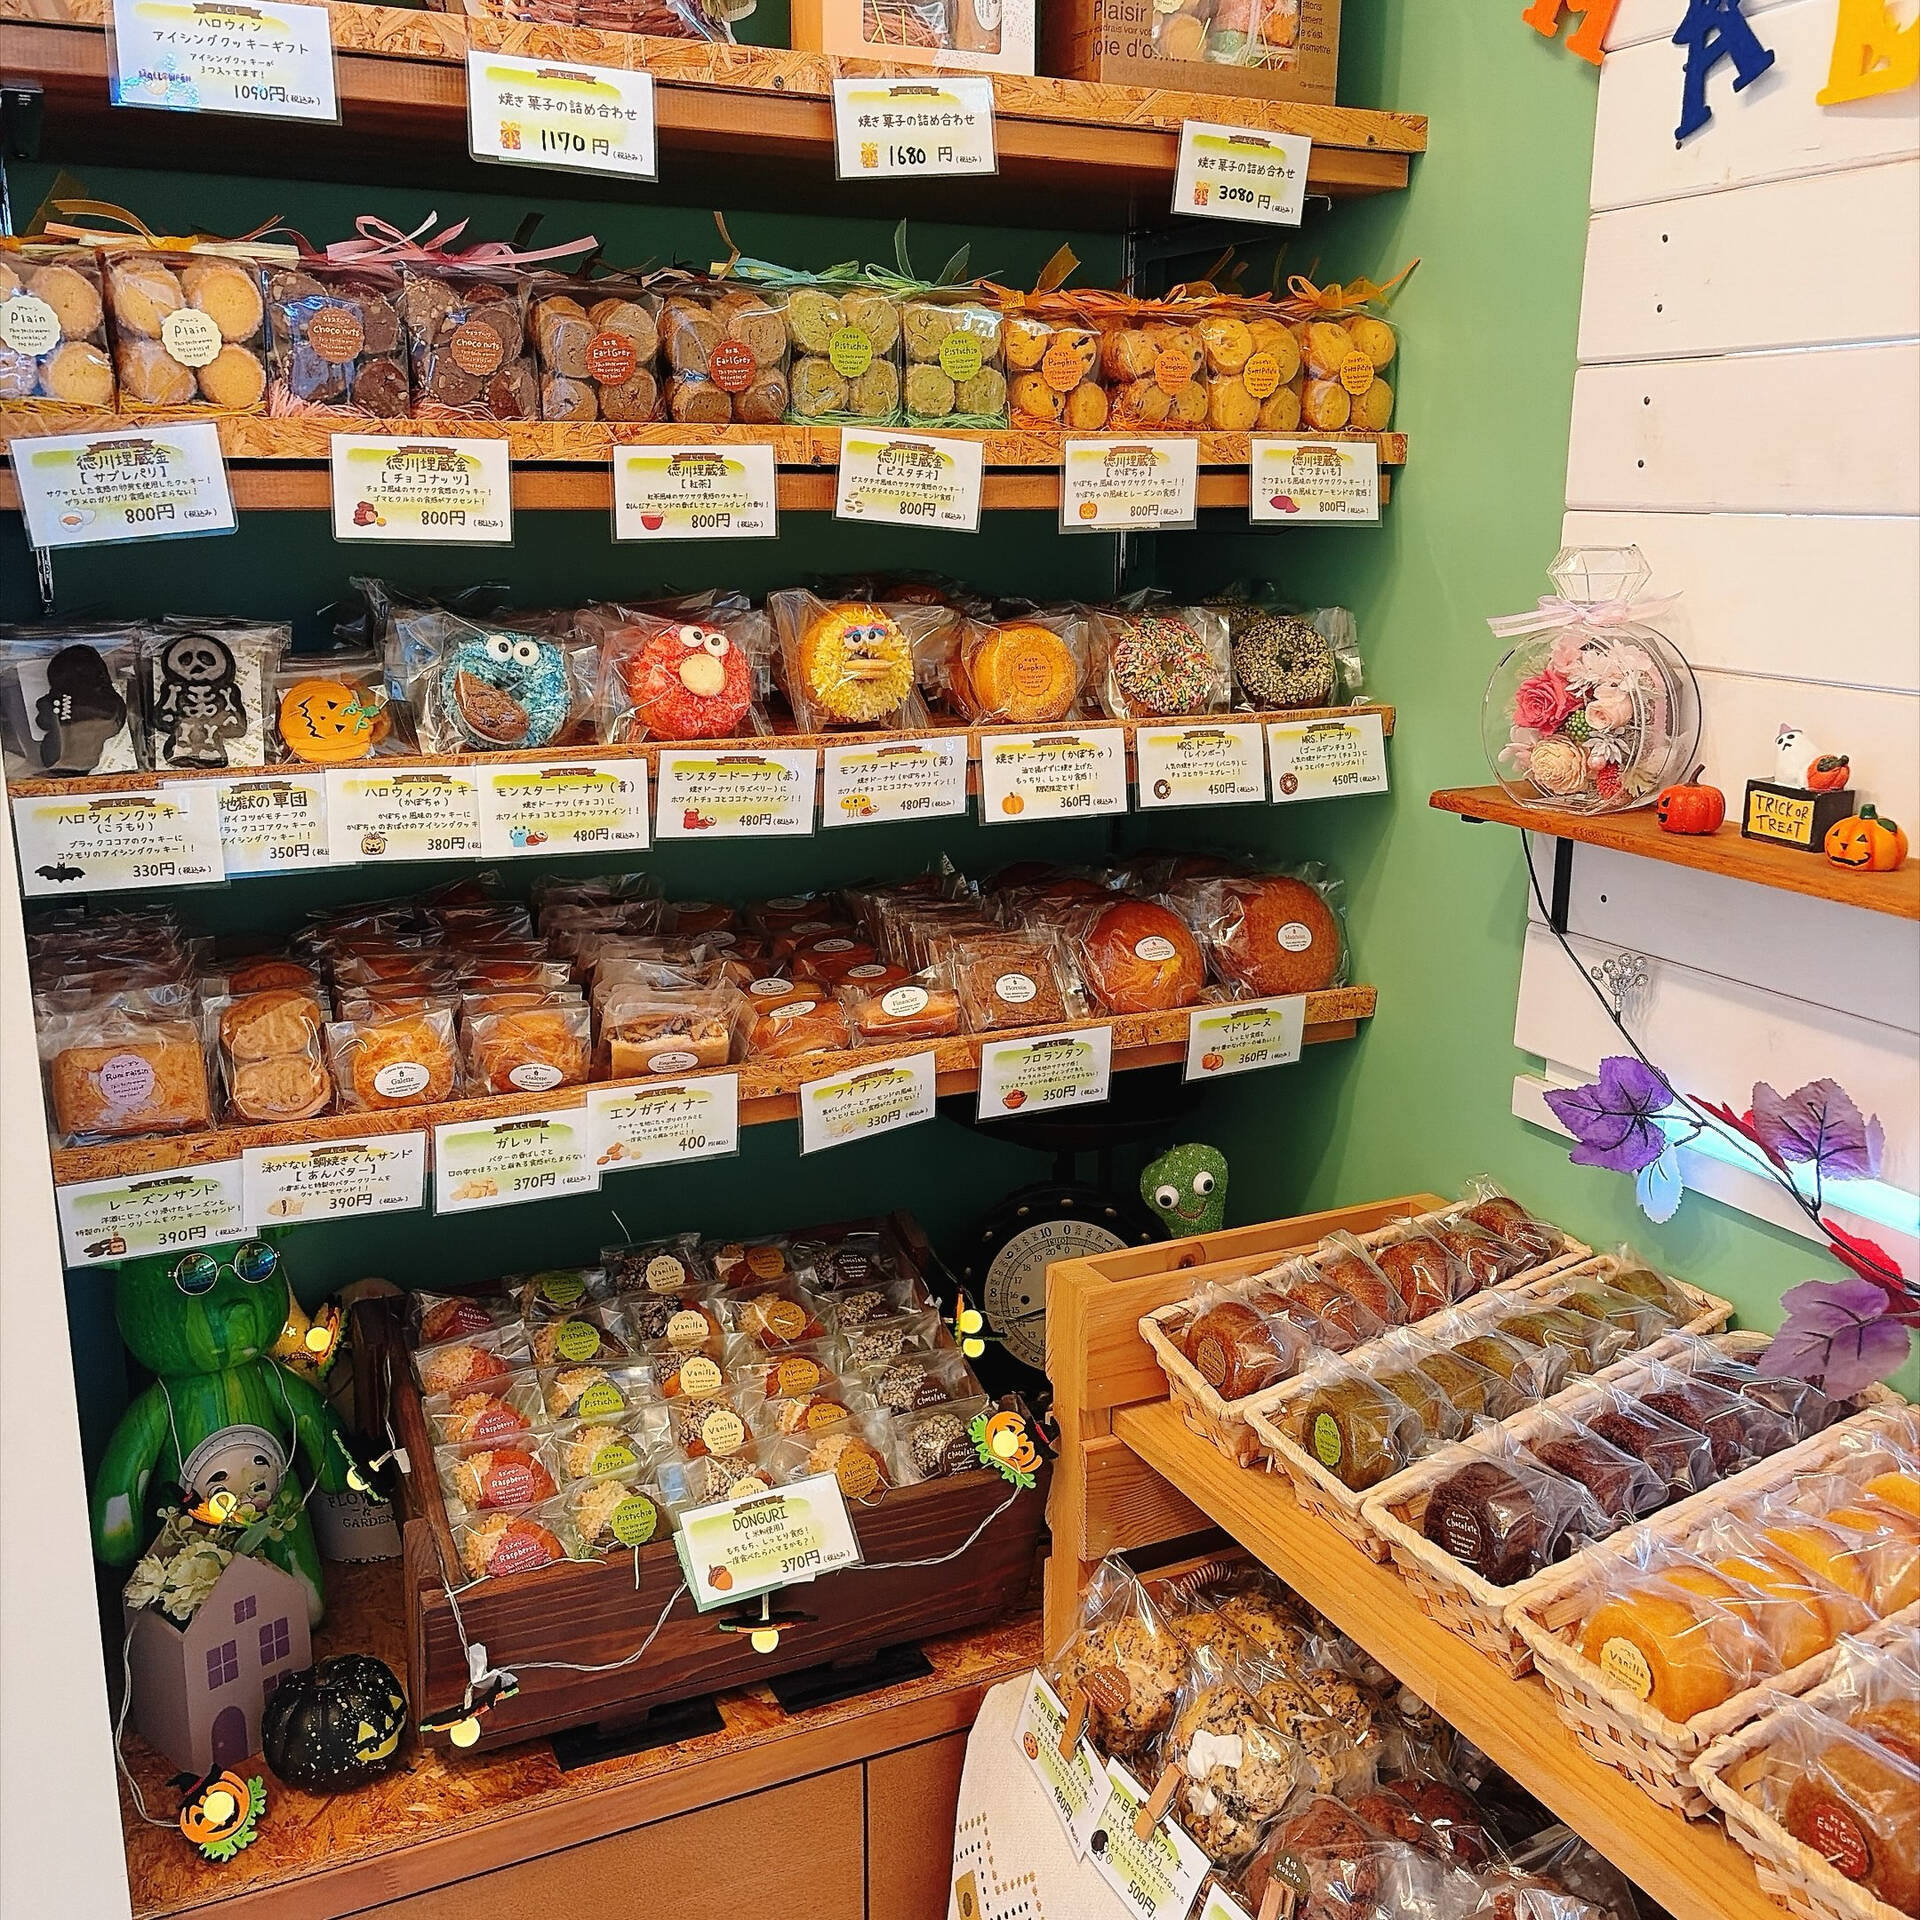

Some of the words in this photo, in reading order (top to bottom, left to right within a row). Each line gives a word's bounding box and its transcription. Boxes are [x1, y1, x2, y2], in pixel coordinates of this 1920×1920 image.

[199, 18, 261, 31] ハロウィン
[152, 30, 310, 55] アイシングクッキーギフト
[498, 93, 637, 121] 焼き菓子の詰め合わせ
[858, 113, 976, 128] 焼き菓子の詰め合わせ
[1197, 156, 1296, 179] 焼き菓子の詰め合わせ
[10, 311, 46, 325] Plain
[174, 324, 207, 337] Plain
[386, 455, 470, 473] 徳川埋蔵金
[365, 785, 479, 798] ハロウィンクッキー
[398, 798, 449, 807] (かぼちゃ)
[1756, 794, 1794, 818] TRICK
[1796, 806, 1809, 819] OR
[58, 807, 189, 826] ハロウィンクッキー
[97, 821, 154, 834] (こうもり)
[1756, 814, 1804, 839] TREAT
[1022, 1048, 1084, 1065] フロランタン
[834, 1075, 904, 1099] フィナンシェ
[610, 1098, 709, 1120] エンガディナー
[495, 1133, 549, 1149] ガレット
[109, 1183, 218, 1211] レーズンサンド
[732, 1506, 789, 1531] DONGURI
